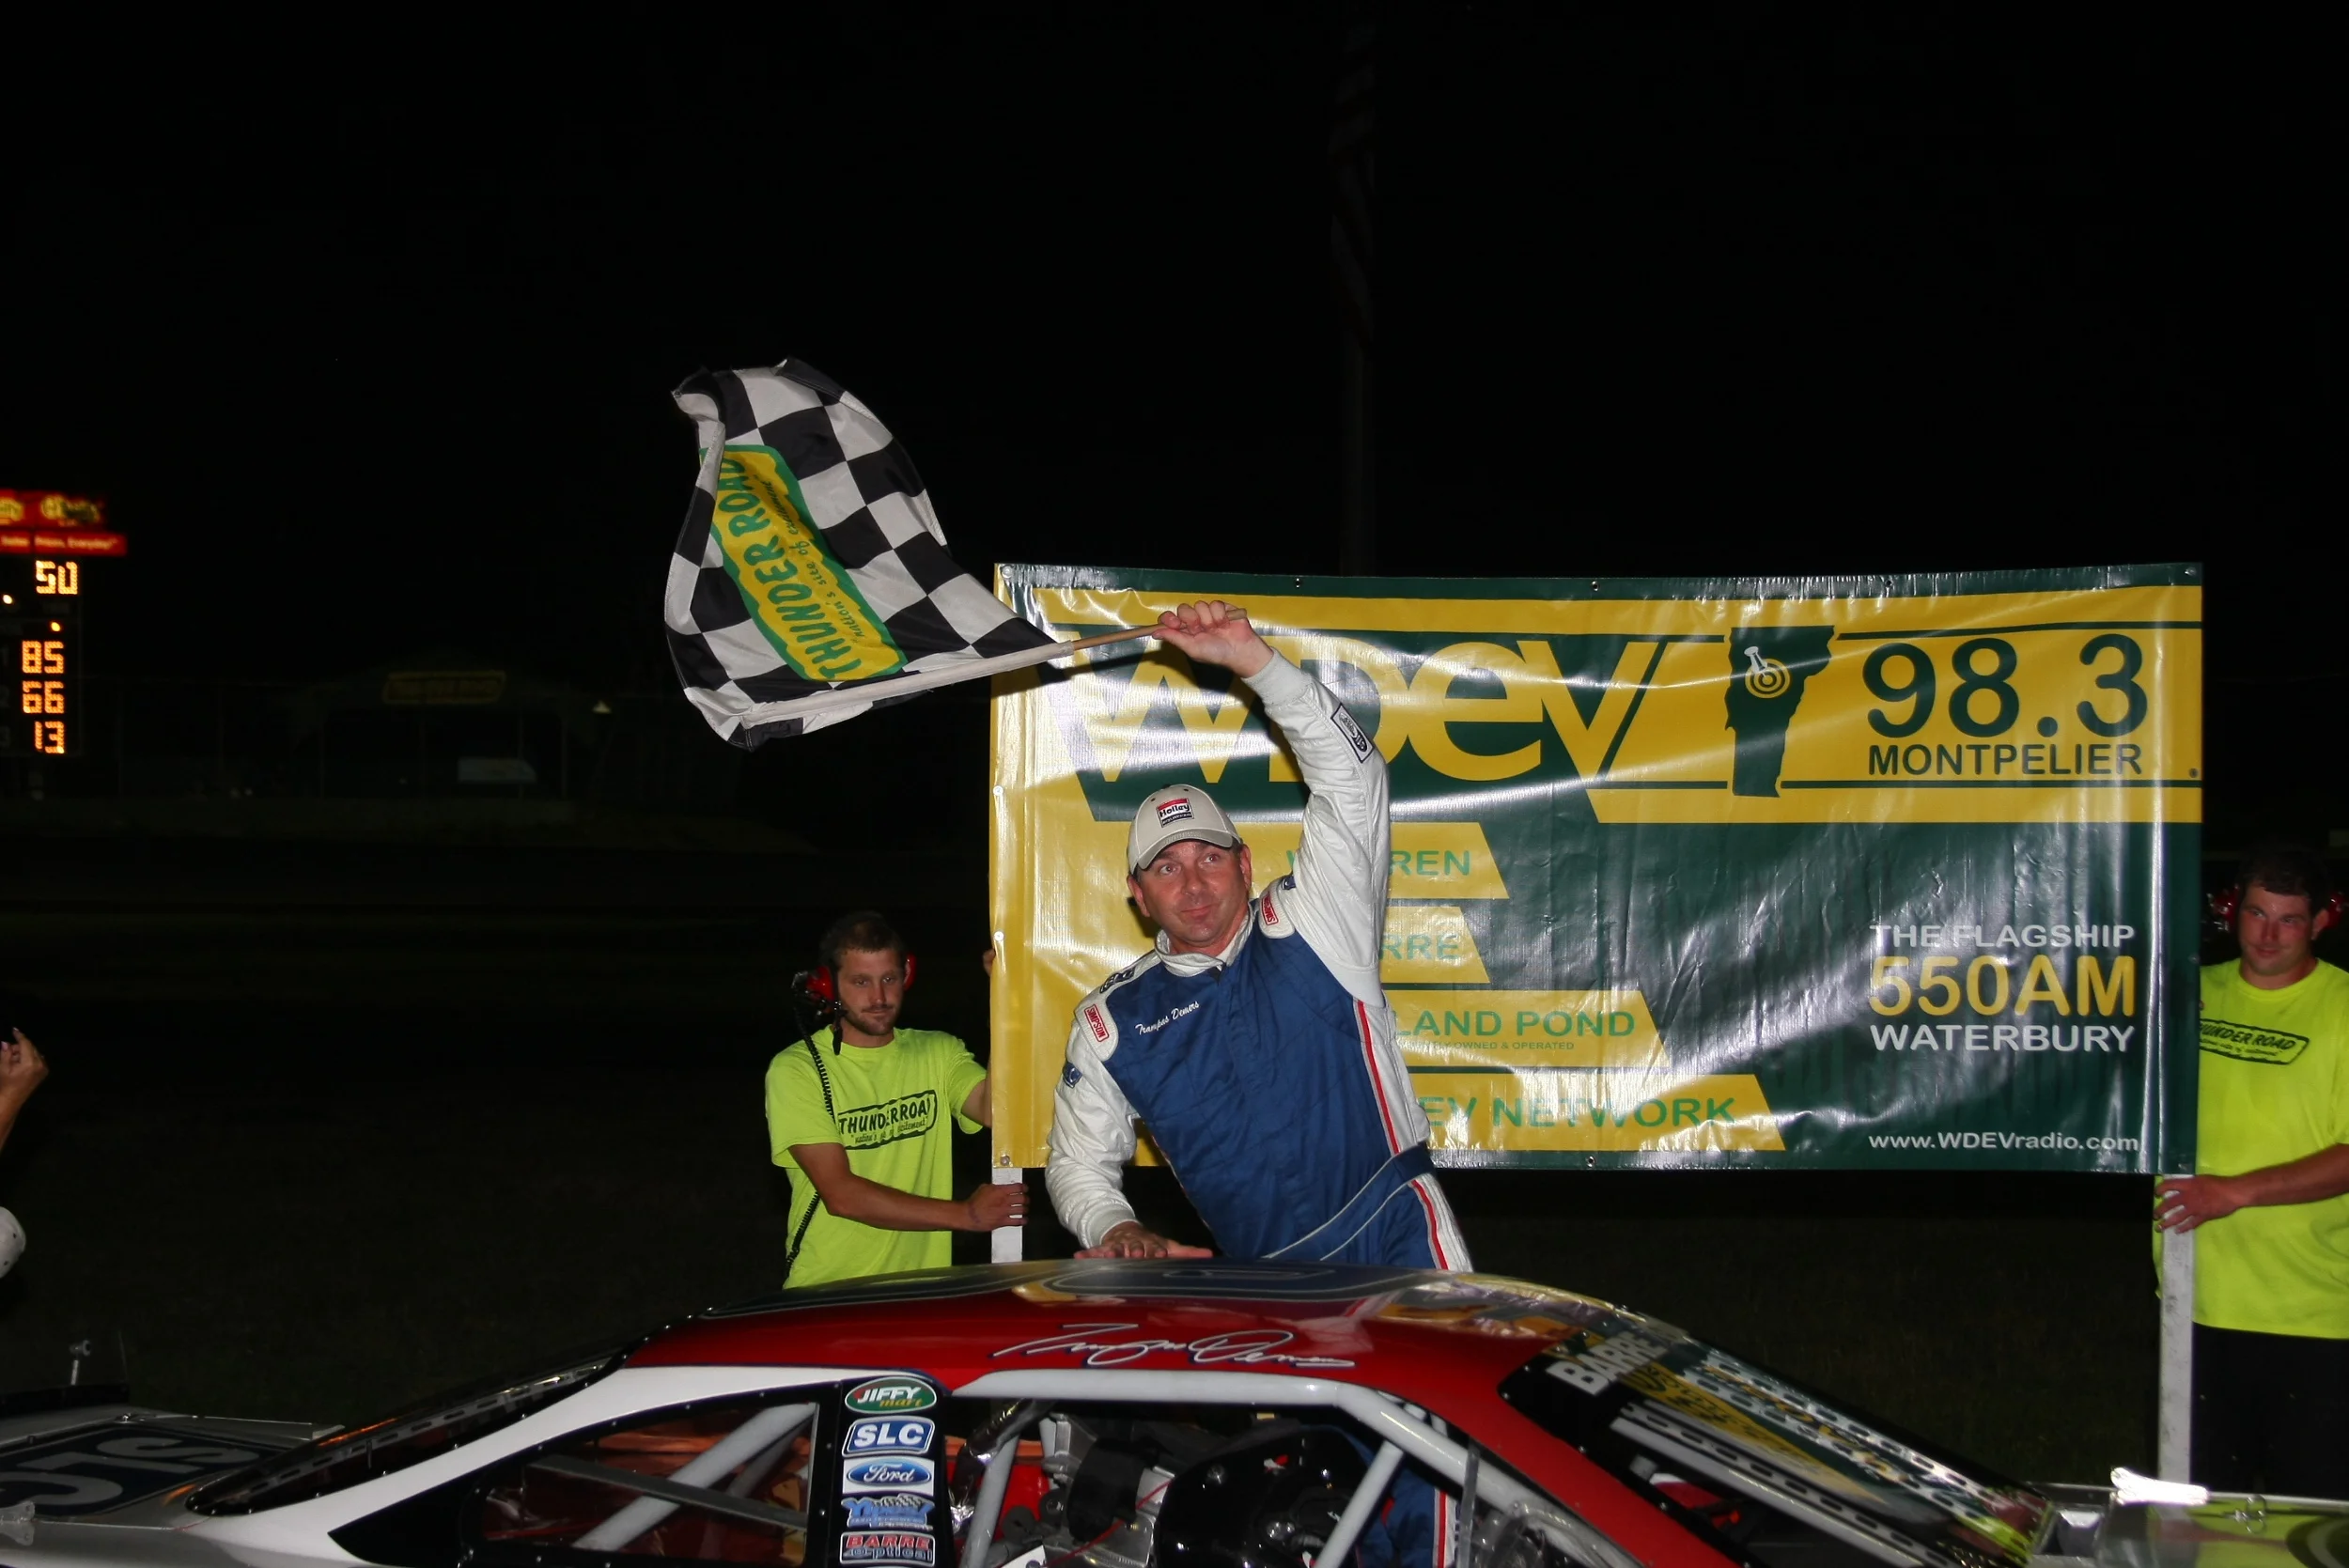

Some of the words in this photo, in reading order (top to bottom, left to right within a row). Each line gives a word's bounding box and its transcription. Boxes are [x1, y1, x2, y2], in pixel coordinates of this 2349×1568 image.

[716, 458, 772, 538] ROAD
[788, 540, 809, 556] of
[35, 560, 78, 594] 50
[805, 561, 827, 586] site
[743, 534, 863, 680] THUNDER
[22, 640, 64, 675] 85
[22, 680, 64, 714] 66
[1862, 633, 2149, 738] 98.3
[35, 720, 65, 754] 13
[1868, 742, 2142, 776] MONTPELIER
[1159, 804, 1190, 818] Holley
[1379, 933, 1460, 960] RRE
[1869, 924, 1942, 948] THE
[1954, 924, 2135, 948] FLAGSHIP
[1869, 955, 2137, 1017] 550AM
[1087, 1007, 1107, 1039] SIMPSON
[1515, 1010, 1637, 1038] POND
[1455, 1041, 1498, 1049] OWNED
[1501, 1041, 1509, 1049] &
[1512, 1041, 1575, 1050] OPERATED
[1869, 1024, 2135, 1052] WATERBURY
[2253, 1033, 2296, 1050] ROAD
[1492, 1096, 1735, 1127] NETWORK
[1868, 1131, 2139, 1152] www.WDEVradio.com
[1545, 1330, 1670, 1396] BARRE
[857, 1387, 921, 1404] JIFFY
[879, 1398, 923, 1407] mart
[853, 1422, 925, 1448] SLC
[863, 1463, 915, 1483] Ford
[847, 1534, 930, 1550] BARRE
